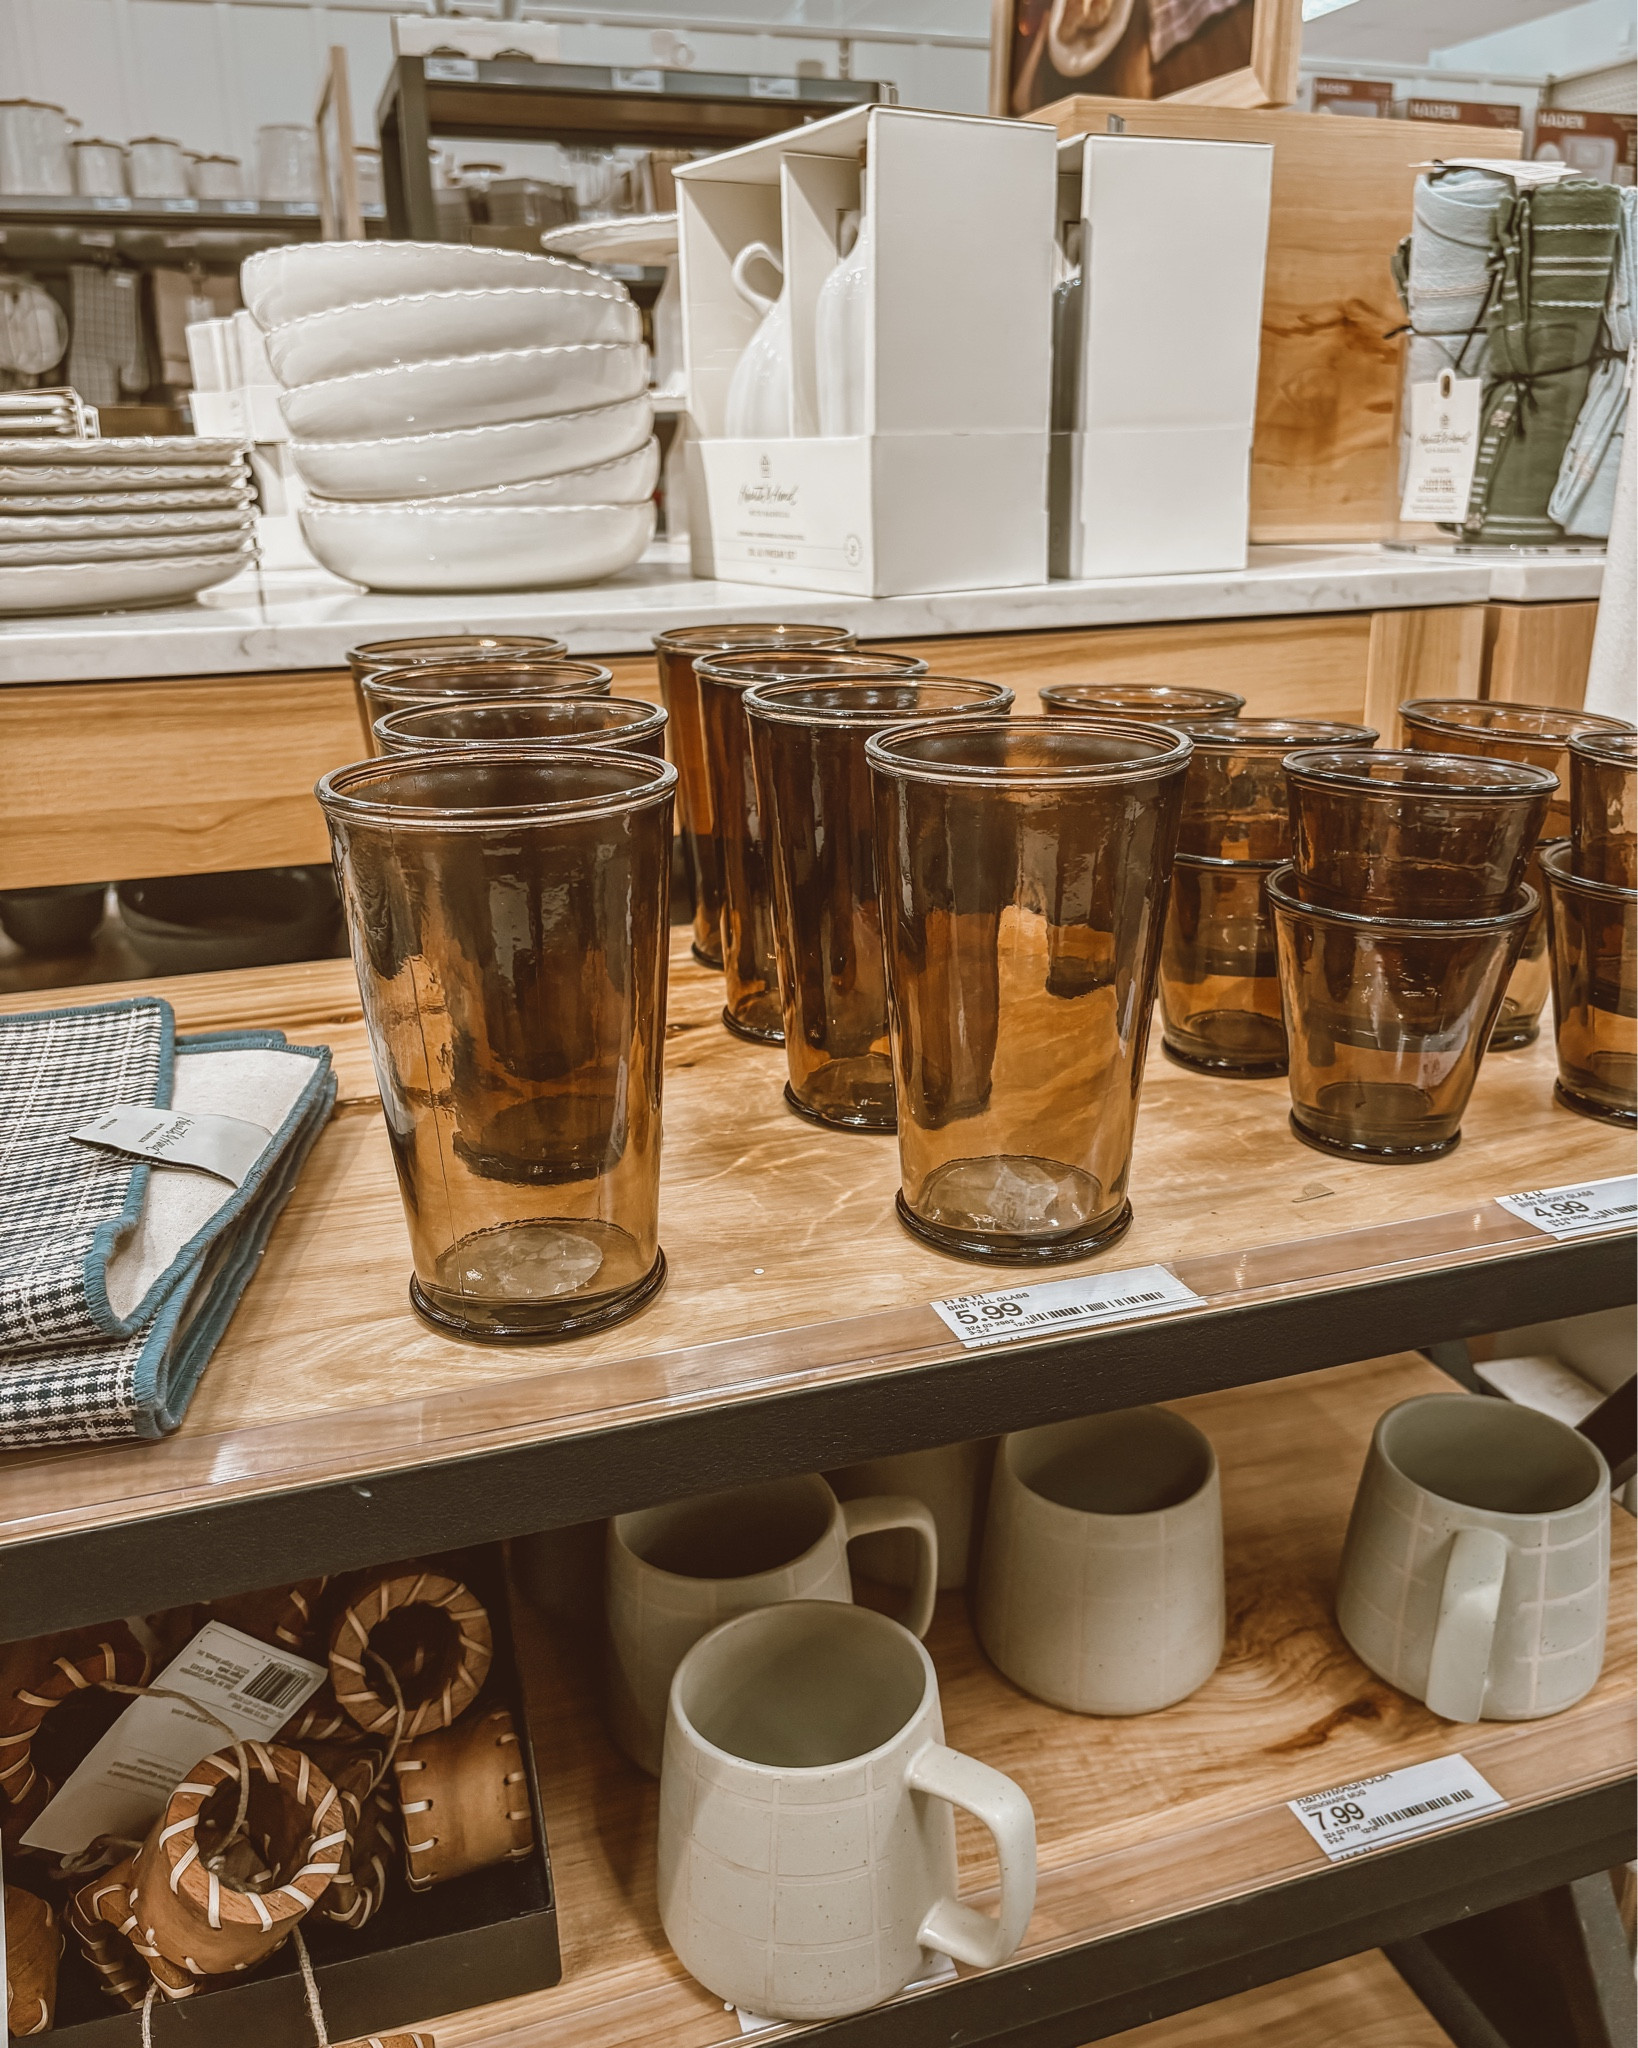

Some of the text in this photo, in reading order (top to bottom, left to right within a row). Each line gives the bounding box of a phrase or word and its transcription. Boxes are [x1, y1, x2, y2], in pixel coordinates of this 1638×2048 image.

[1537, 1195, 1565, 1205] SHORT
[1566, 1190, 1595, 1199] GLASS
[1533, 1200, 1590, 1218] 4.99
[969, 1299, 996, 1307] TALL
[996, 1292, 1030, 1302] GLASS
[954, 1302, 1023, 1325] 5.99
[1347, 1788, 1367, 1799] MUG
[1307, 1802, 1365, 1831] 7.99
